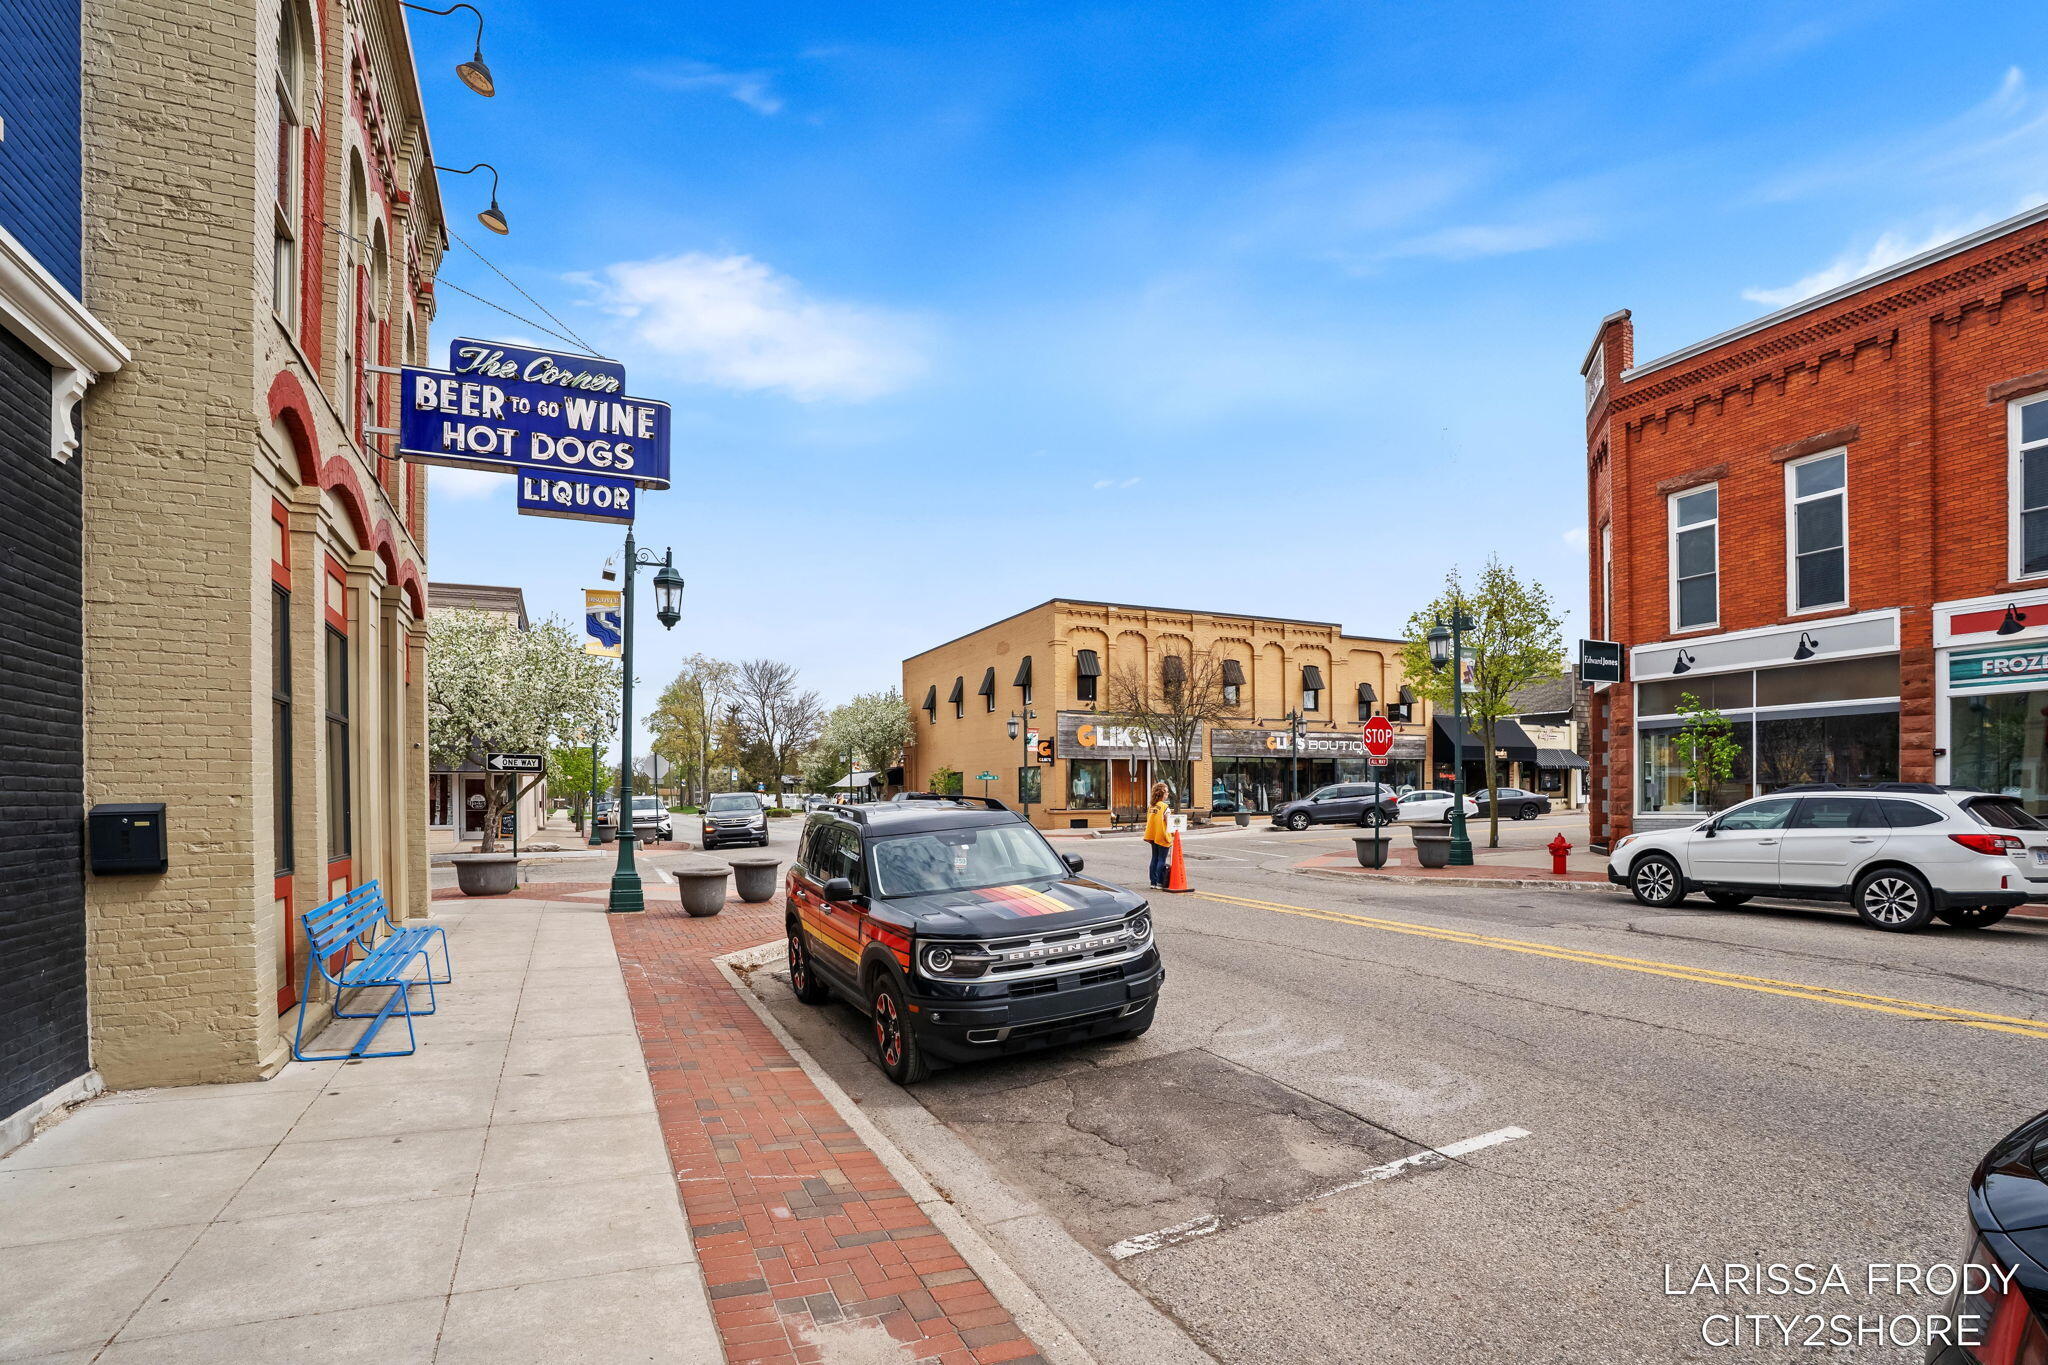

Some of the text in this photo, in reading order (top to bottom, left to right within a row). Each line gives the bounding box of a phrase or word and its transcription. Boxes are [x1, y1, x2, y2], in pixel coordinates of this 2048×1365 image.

[455, 346, 621, 393] The Corner
[415, 375, 655, 439] BEER TO GO WINE
[442, 421, 635, 471] HOT DOGS
[524, 477, 630, 510] LIQUOR
[1365, 729, 1392, 744] STOP
[1009, 938, 1115, 960] BRONCO
